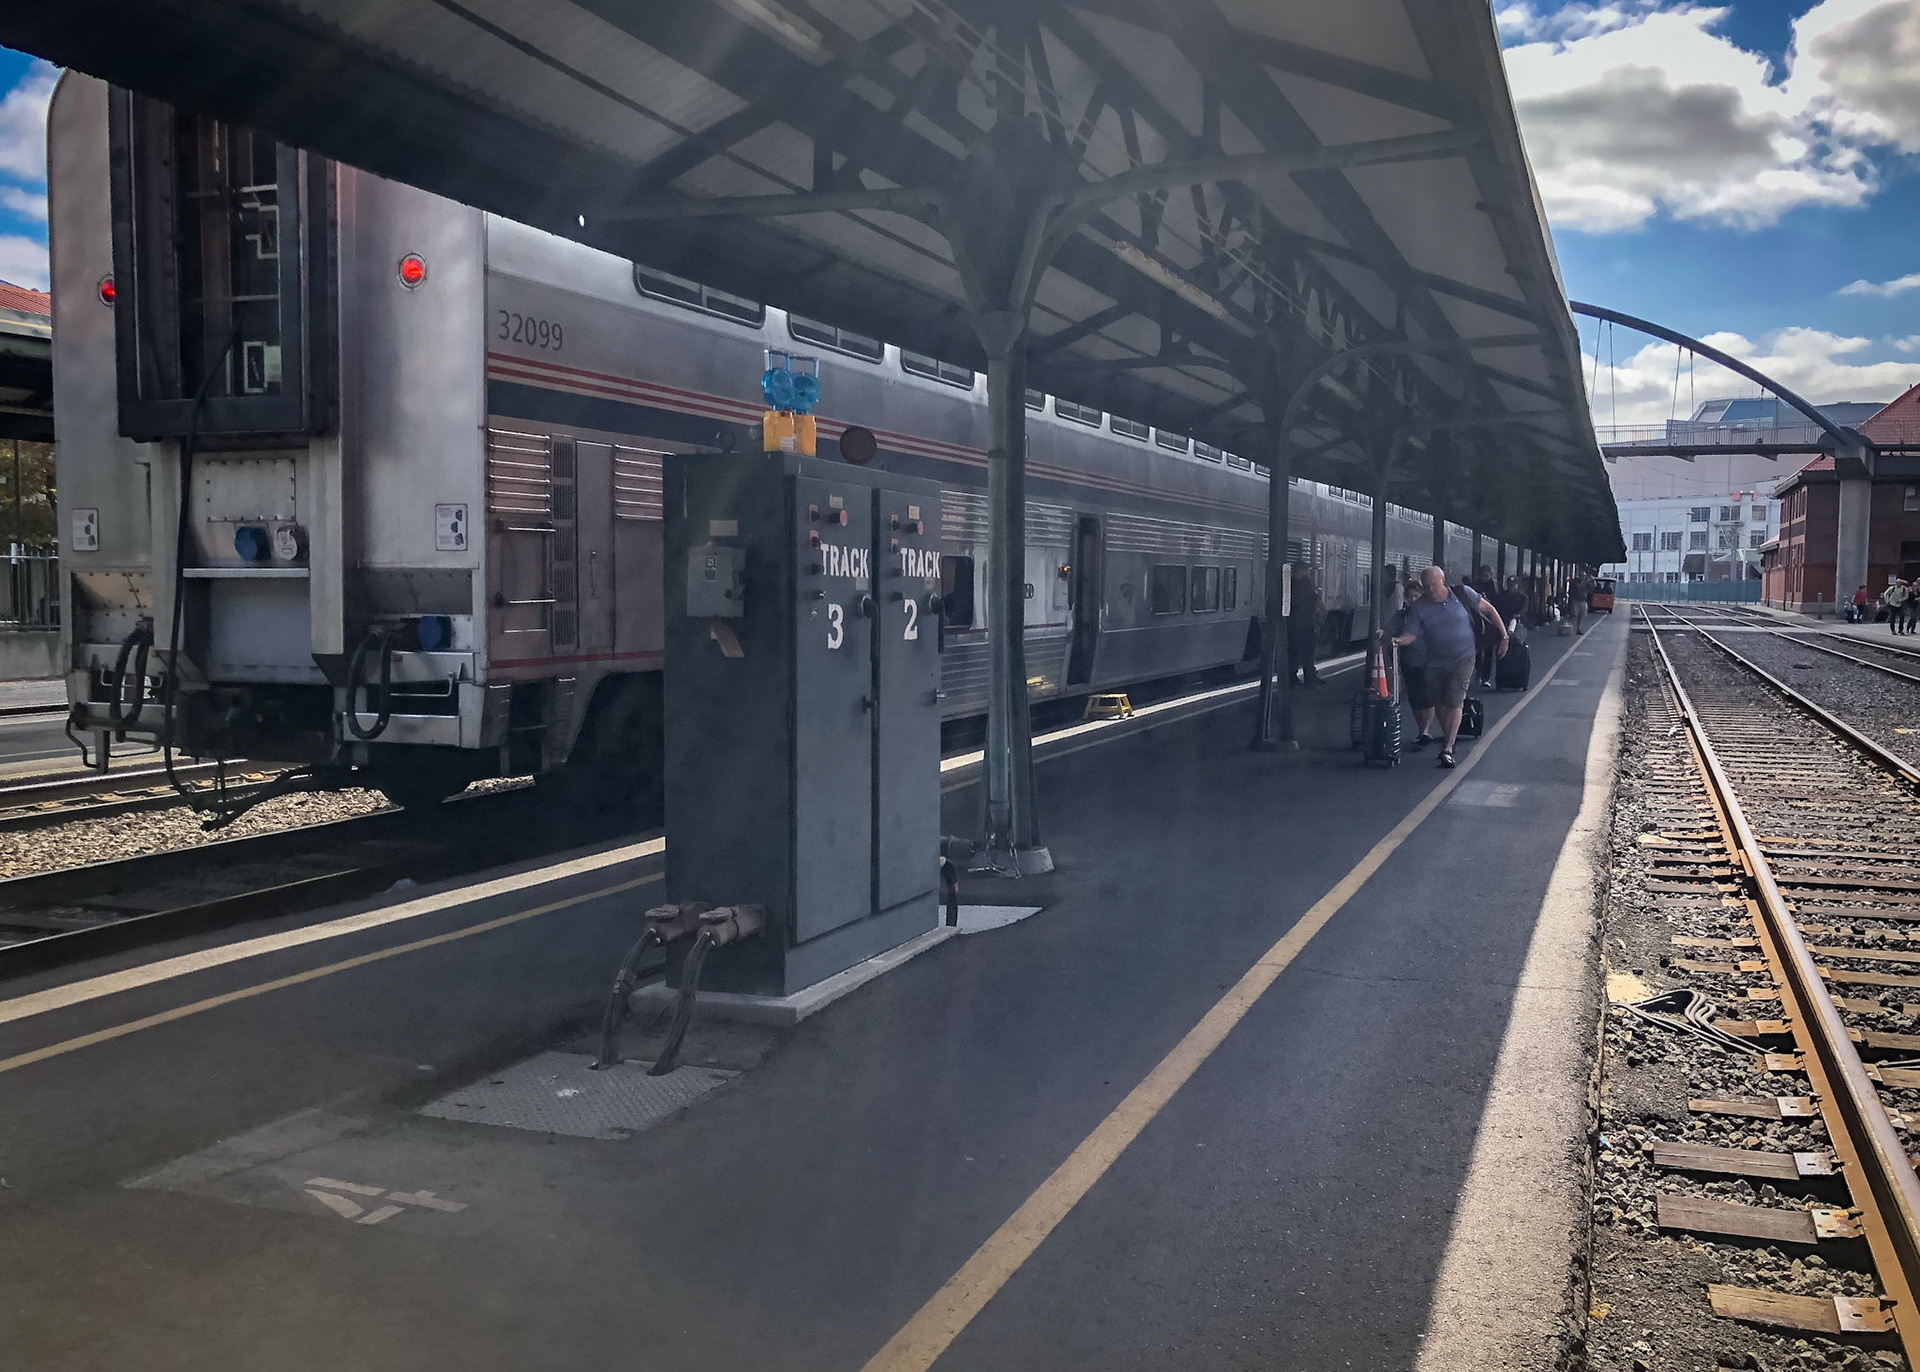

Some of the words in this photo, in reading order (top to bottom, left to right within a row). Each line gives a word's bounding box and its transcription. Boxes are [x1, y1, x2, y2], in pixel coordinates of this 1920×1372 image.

[499, 310, 562, 351] 32099
[820, 543, 869, 578] TRACK
[900, 547, 940, 578] TRACK
[828, 603, 844, 649] 3
[904, 599, 918, 640] 2
[303, 1176, 469, 1225] 4
